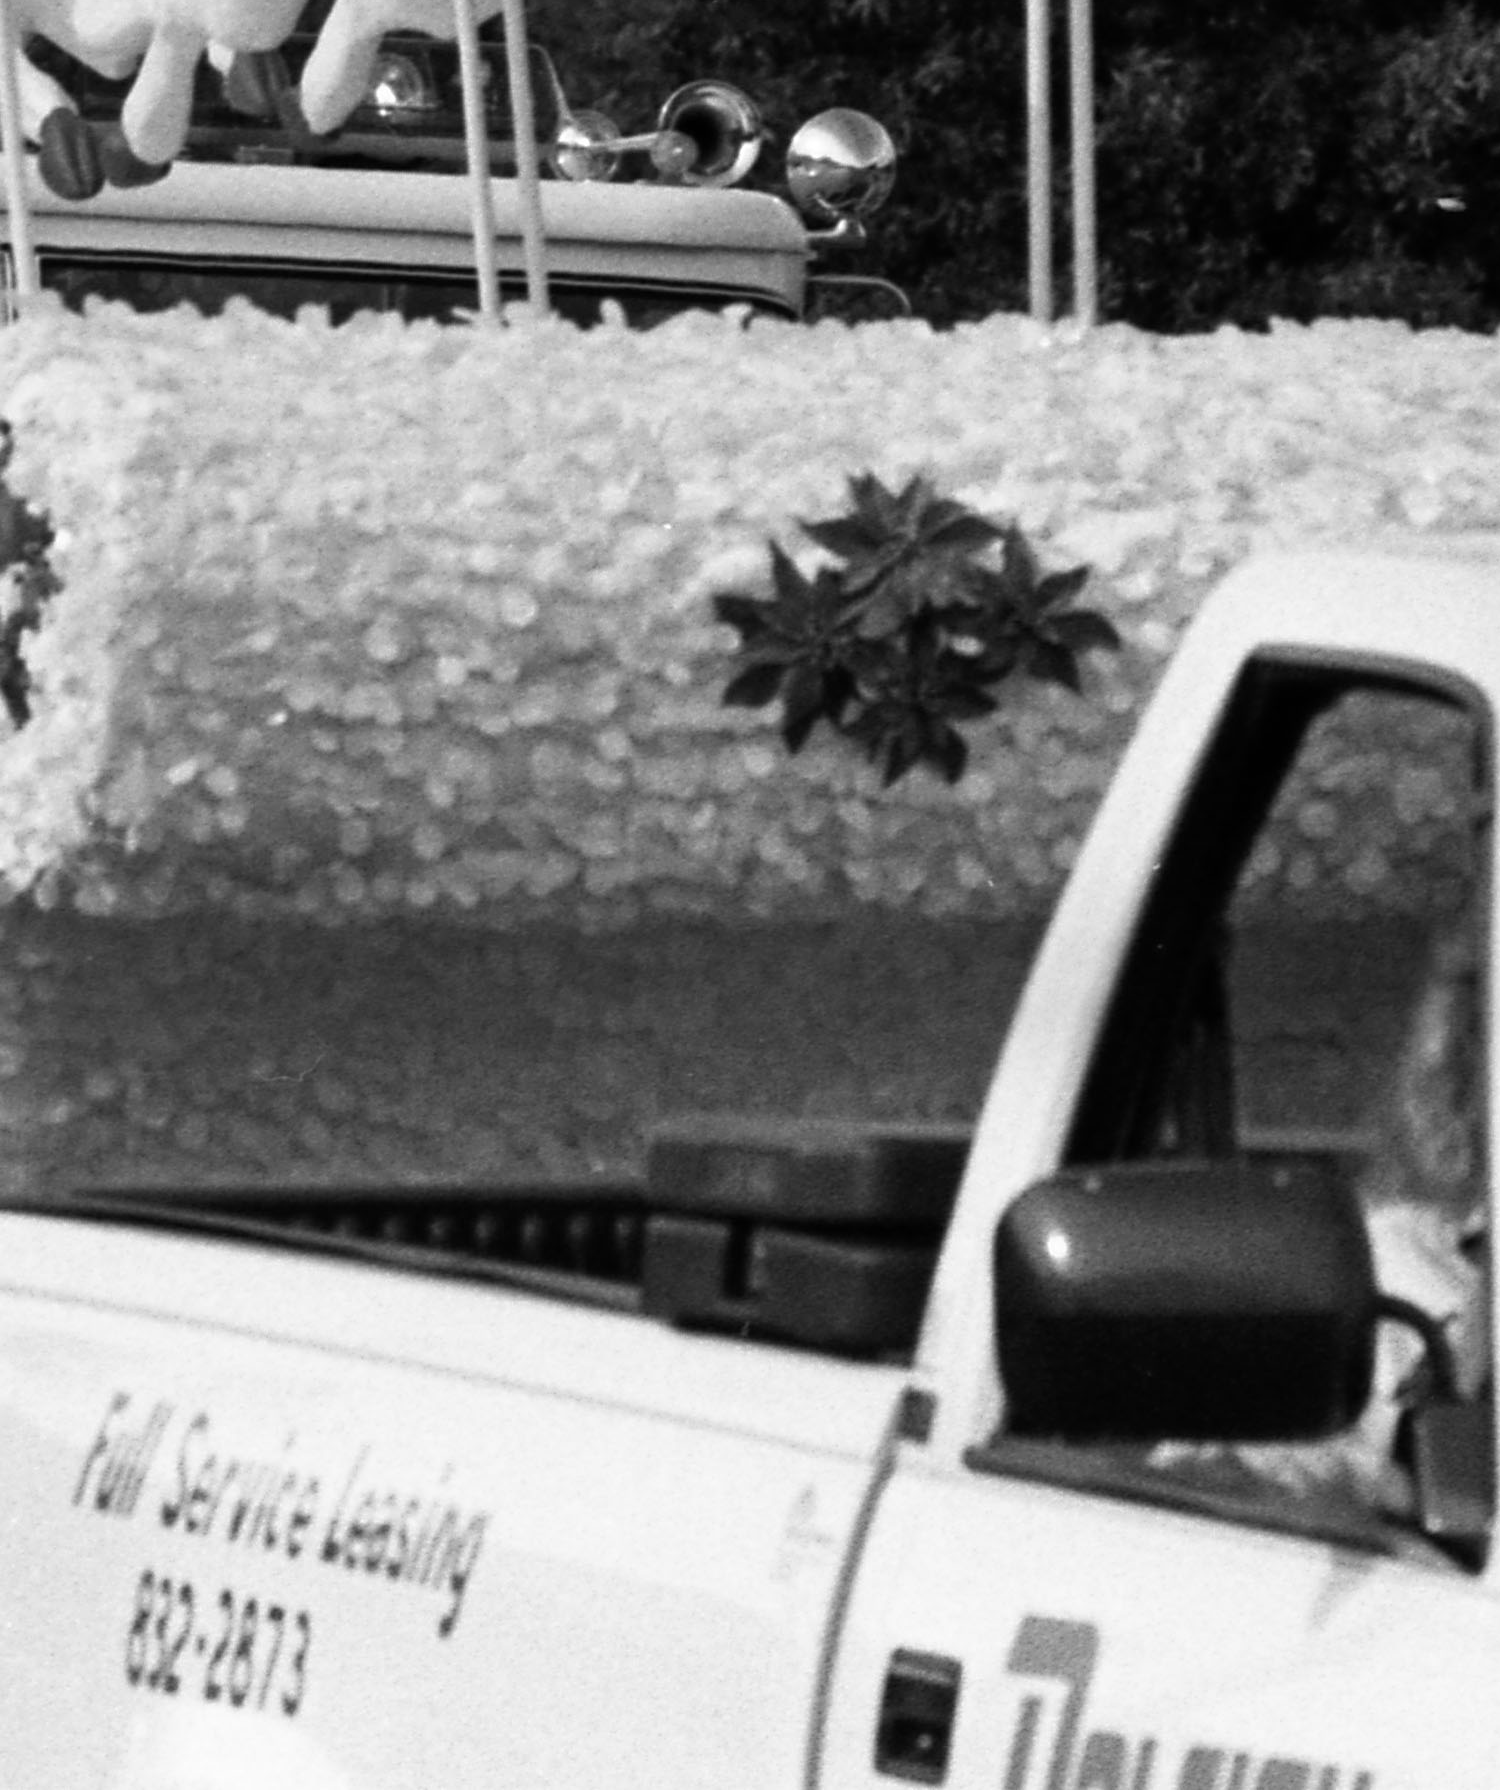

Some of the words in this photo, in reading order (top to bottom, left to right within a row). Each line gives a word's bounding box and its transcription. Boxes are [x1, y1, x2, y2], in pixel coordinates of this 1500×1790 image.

[72, 1391, 175, 1519] Full
[160, 1412, 321, 1560] Service
[319, 1445, 491, 1638] Leasing
[126, 1569, 312, 1717] 832-2873
